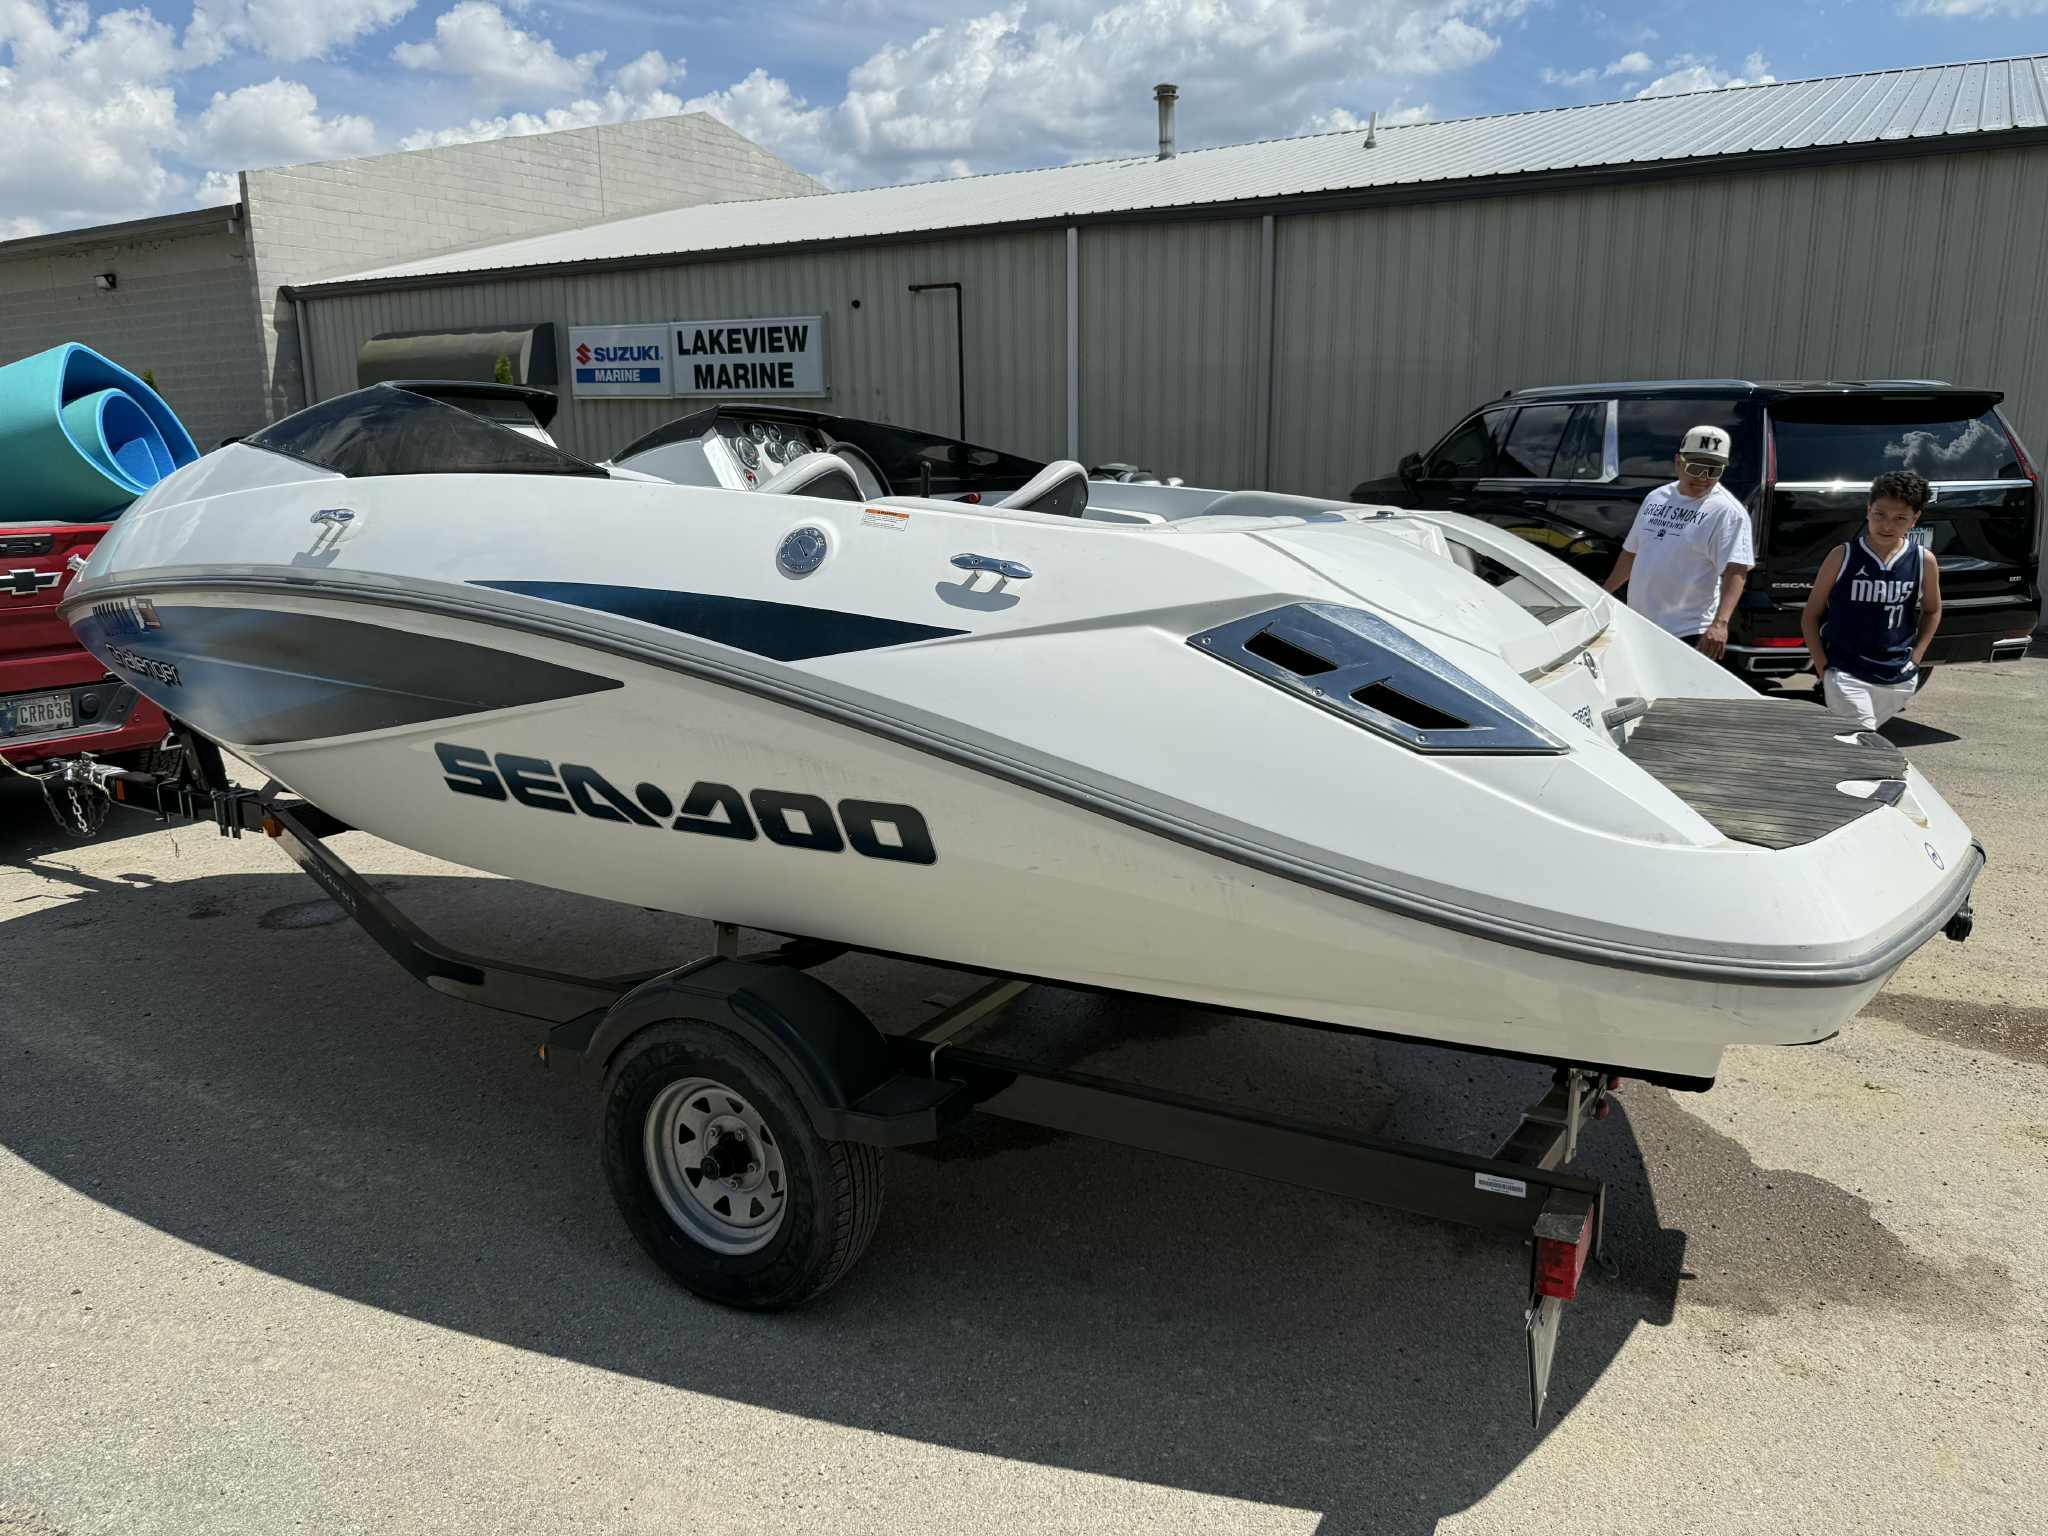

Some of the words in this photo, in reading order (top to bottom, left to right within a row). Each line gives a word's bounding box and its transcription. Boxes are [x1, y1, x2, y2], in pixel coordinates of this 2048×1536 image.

[677, 325, 809, 356] LAKEVIEW
[594, 345, 660, 363] SUZUKI
[594, 369, 641, 382] MARINE
[693, 362, 795, 390] MARINE
[1699, 436, 1722, 450] NY
[1644, 503, 1673, 519] GREAT
[1670, 507, 1709, 525] SMOKY
[1884, 605, 1905, 630] 77
[20, 701, 71, 724] CRR636
